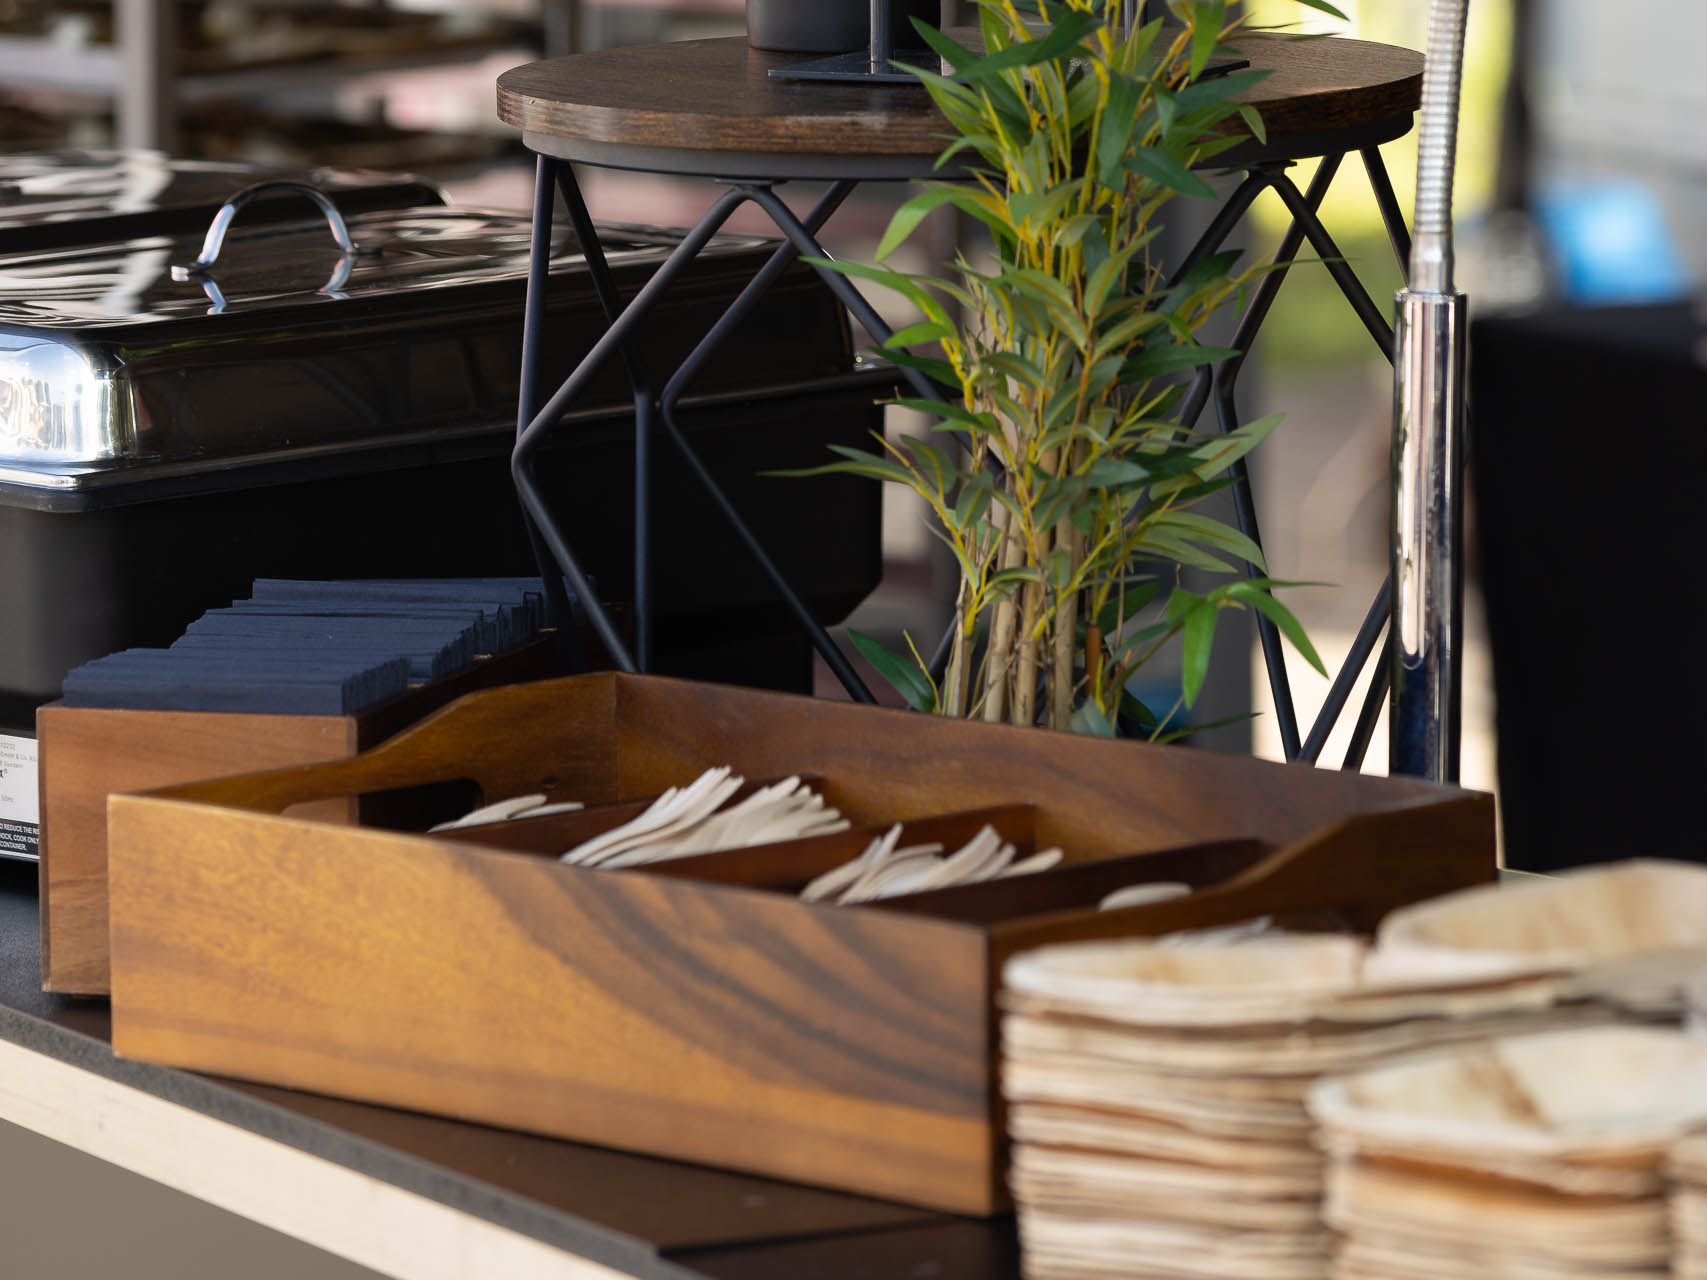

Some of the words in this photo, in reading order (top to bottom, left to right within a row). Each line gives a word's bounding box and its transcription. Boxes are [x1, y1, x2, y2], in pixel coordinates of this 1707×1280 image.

[4, 824, 23, 833] REDUCE
[23, 826, 32, 834] THE
[13, 834, 28, 843] COOK
